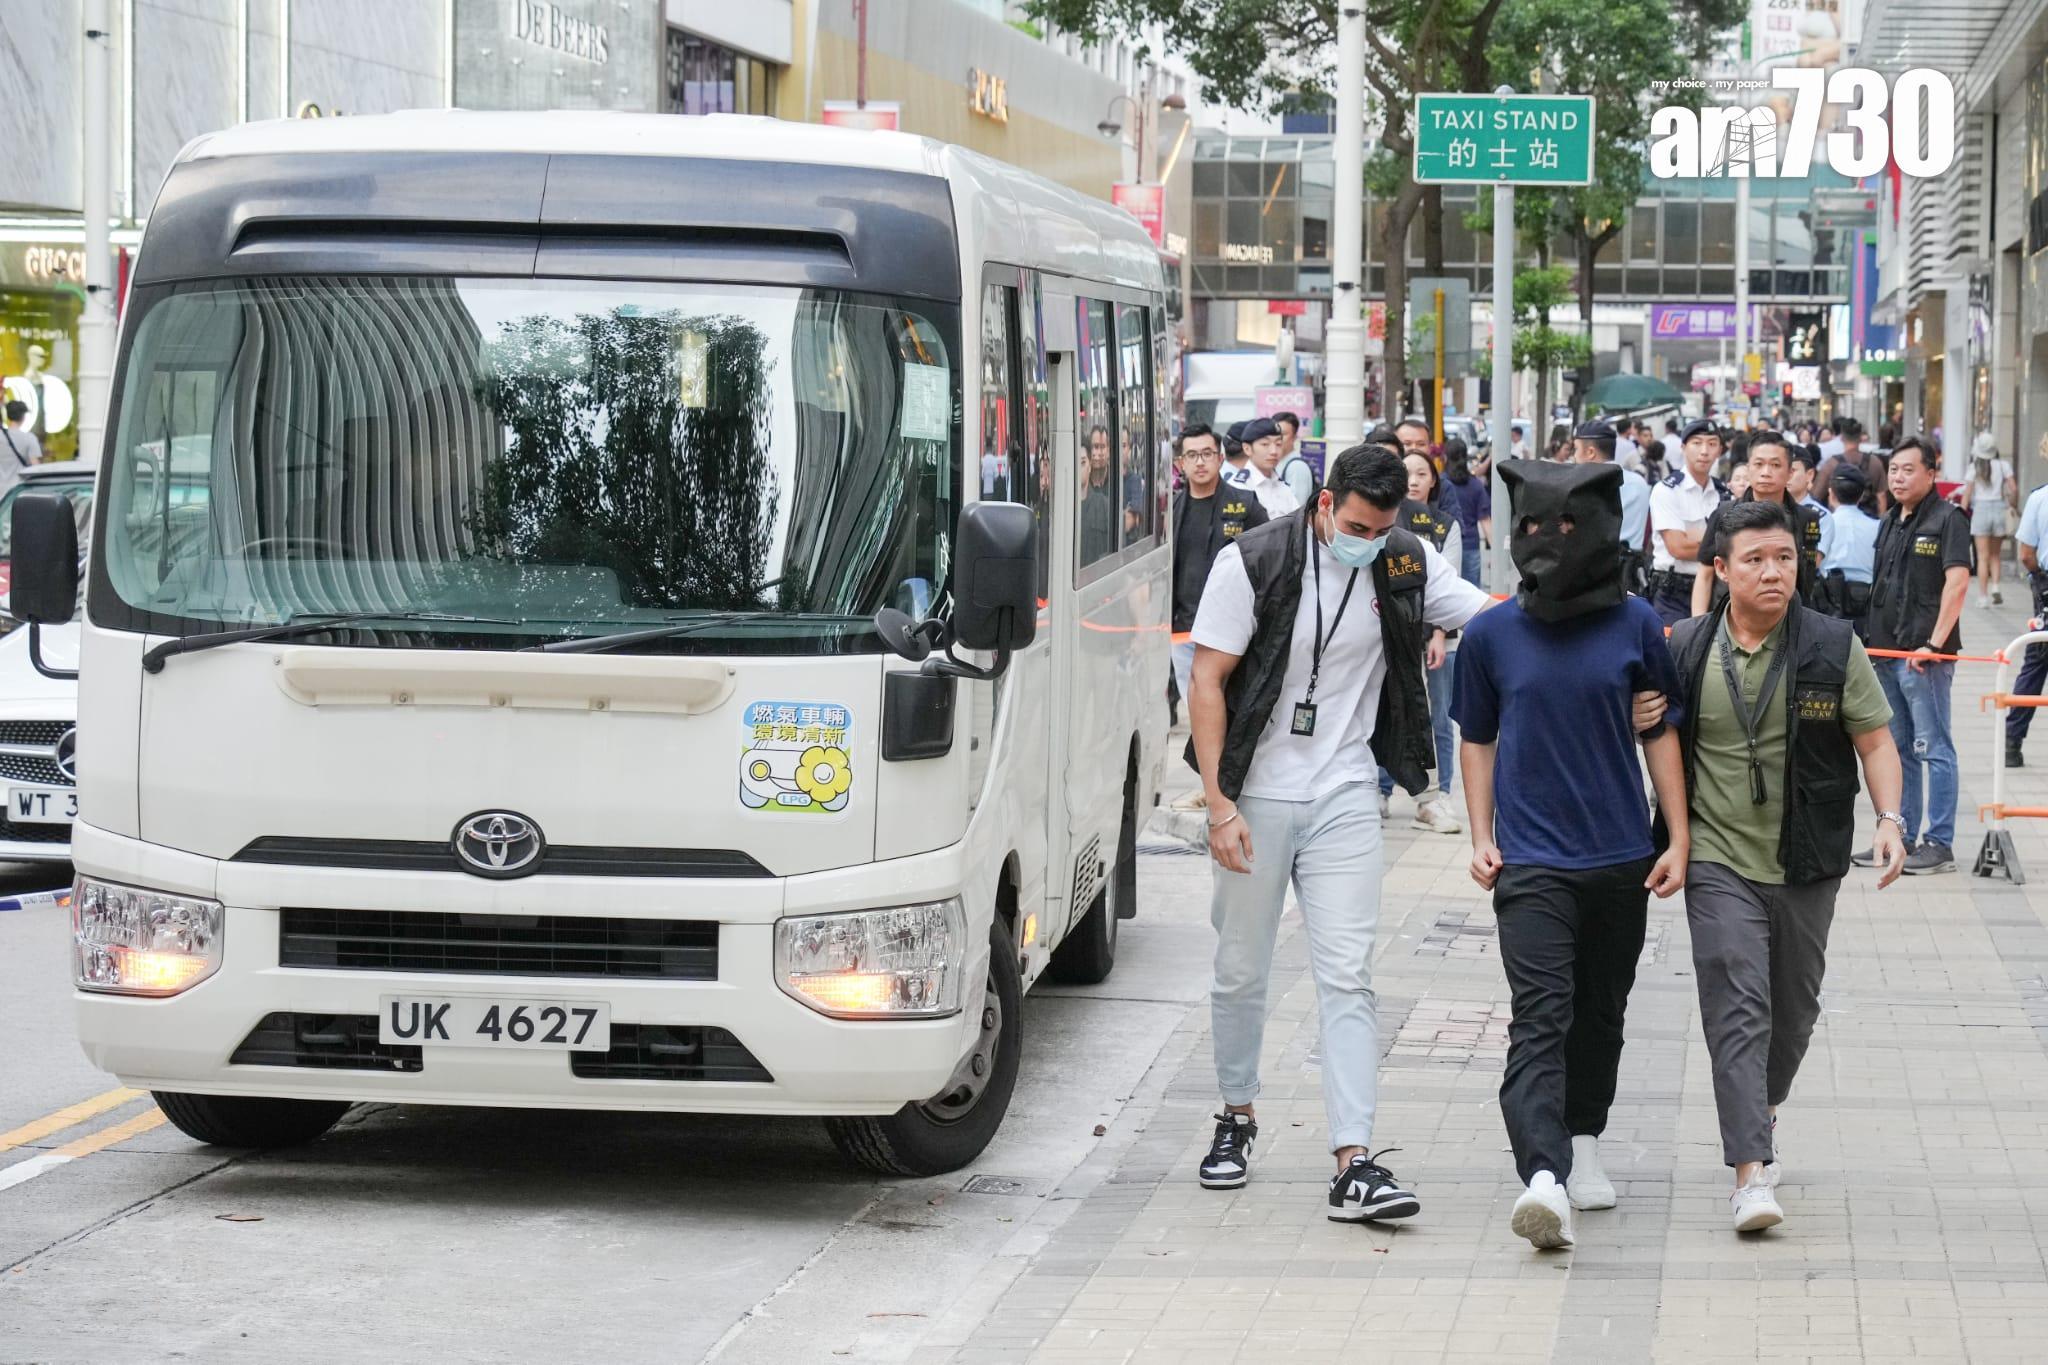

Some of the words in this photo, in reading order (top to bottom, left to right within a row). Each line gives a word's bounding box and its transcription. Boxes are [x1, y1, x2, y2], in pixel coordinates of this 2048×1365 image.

[547, 3, 609, 64] BEERS
[1431, 110, 1483, 130] TAXI
[1493, 110, 1578, 131] STAND
[1448, 136, 1559, 169] 的士站
[1388, 562, 1422, 577] OLICE
[752, 704, 846, 725] 燃氣車輛
[752, 724, 846, 744] 環境清新
[18, 793, 52, 817] WT
[782, 794, 809, 805] LPG
[391, 1001, 451, 1041] UK
[475, 1004, 599, 1045] 4627
